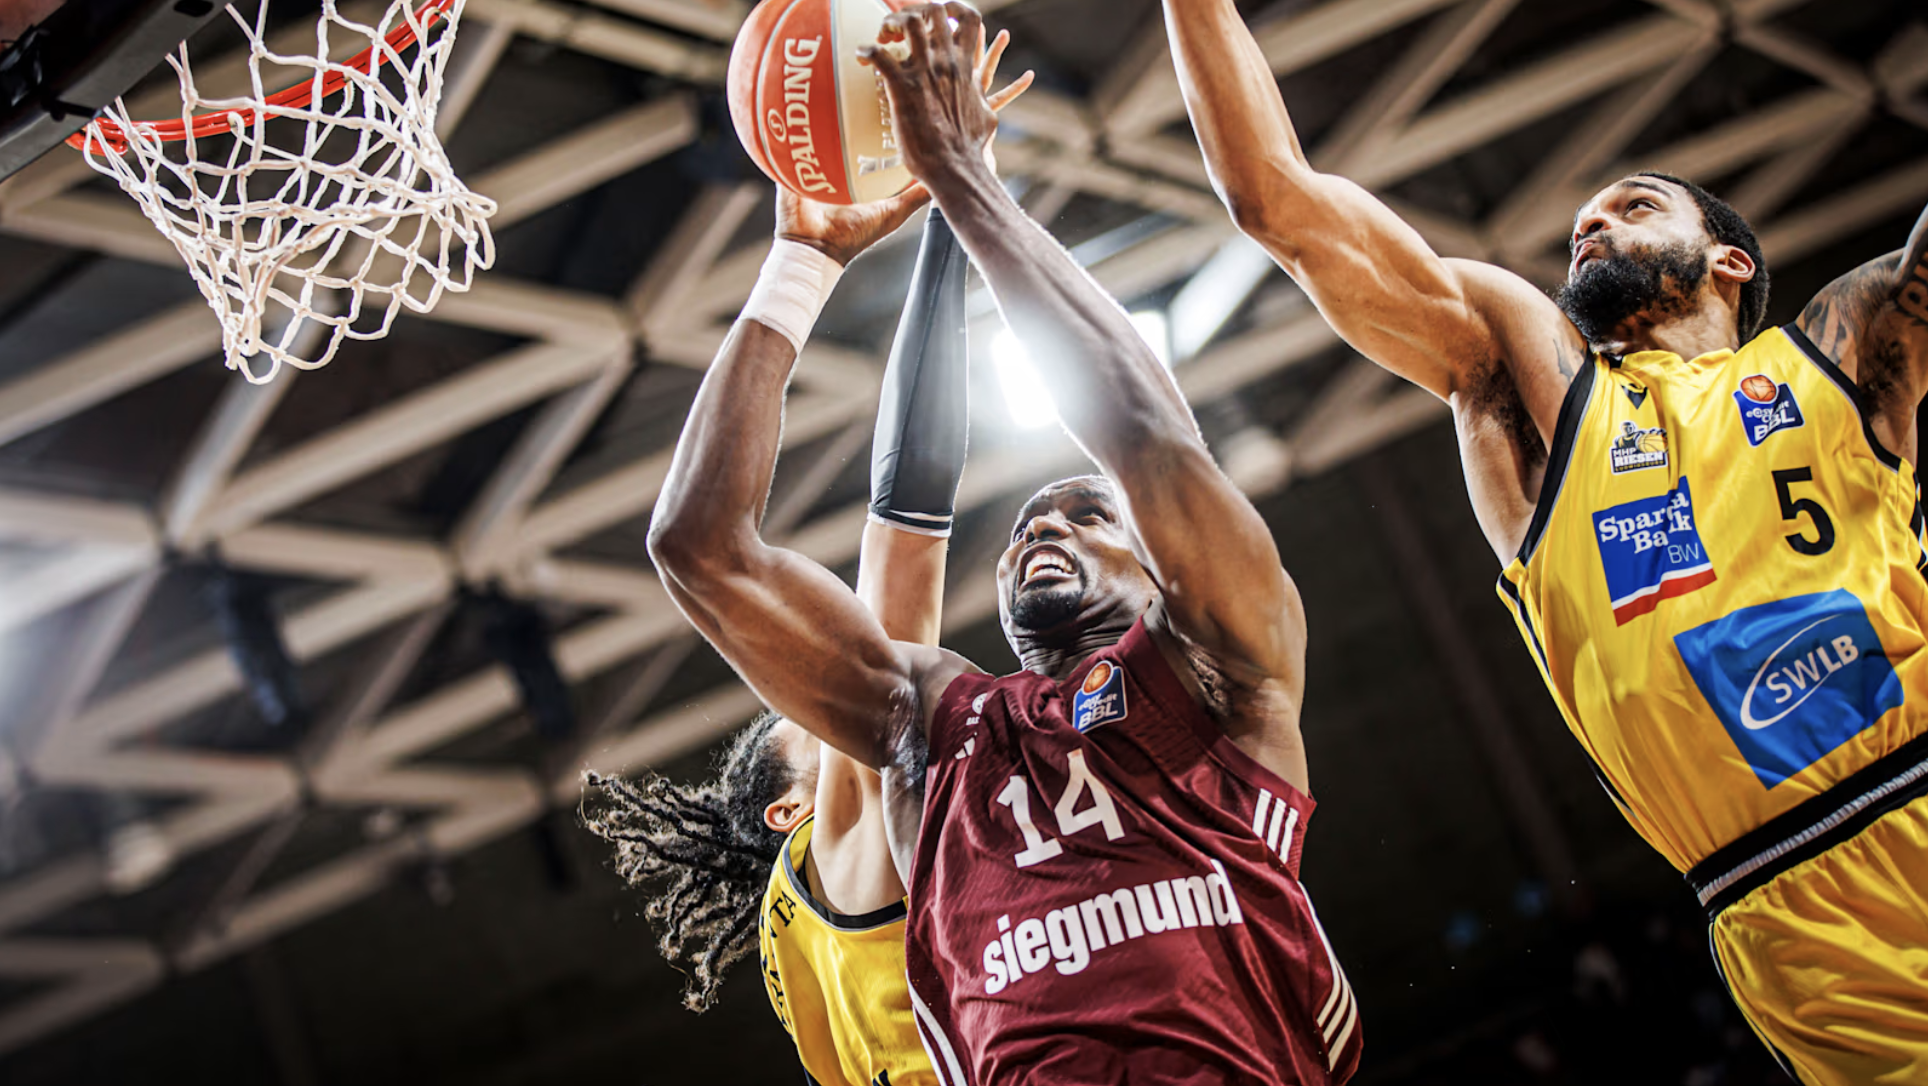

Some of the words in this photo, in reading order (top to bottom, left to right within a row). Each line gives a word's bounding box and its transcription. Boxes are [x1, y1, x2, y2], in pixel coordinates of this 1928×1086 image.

[784, 37, 837, 193] SPALDING
[1754, 409, 1796, 441] BBL
[1613, 448, 1637, 457] MHP
[1615, 452, 1664, 467] RIESEN
[1771, 466, 1835, 556] 5
[1667, 542, 1699, 563] BW
[1765, 635, 1859, 704] SWLB
[1078, 702, 1119, 730] BBL
[996, 748, 1126, 869] 14
[982, 859, 1244, 995] siegmund
